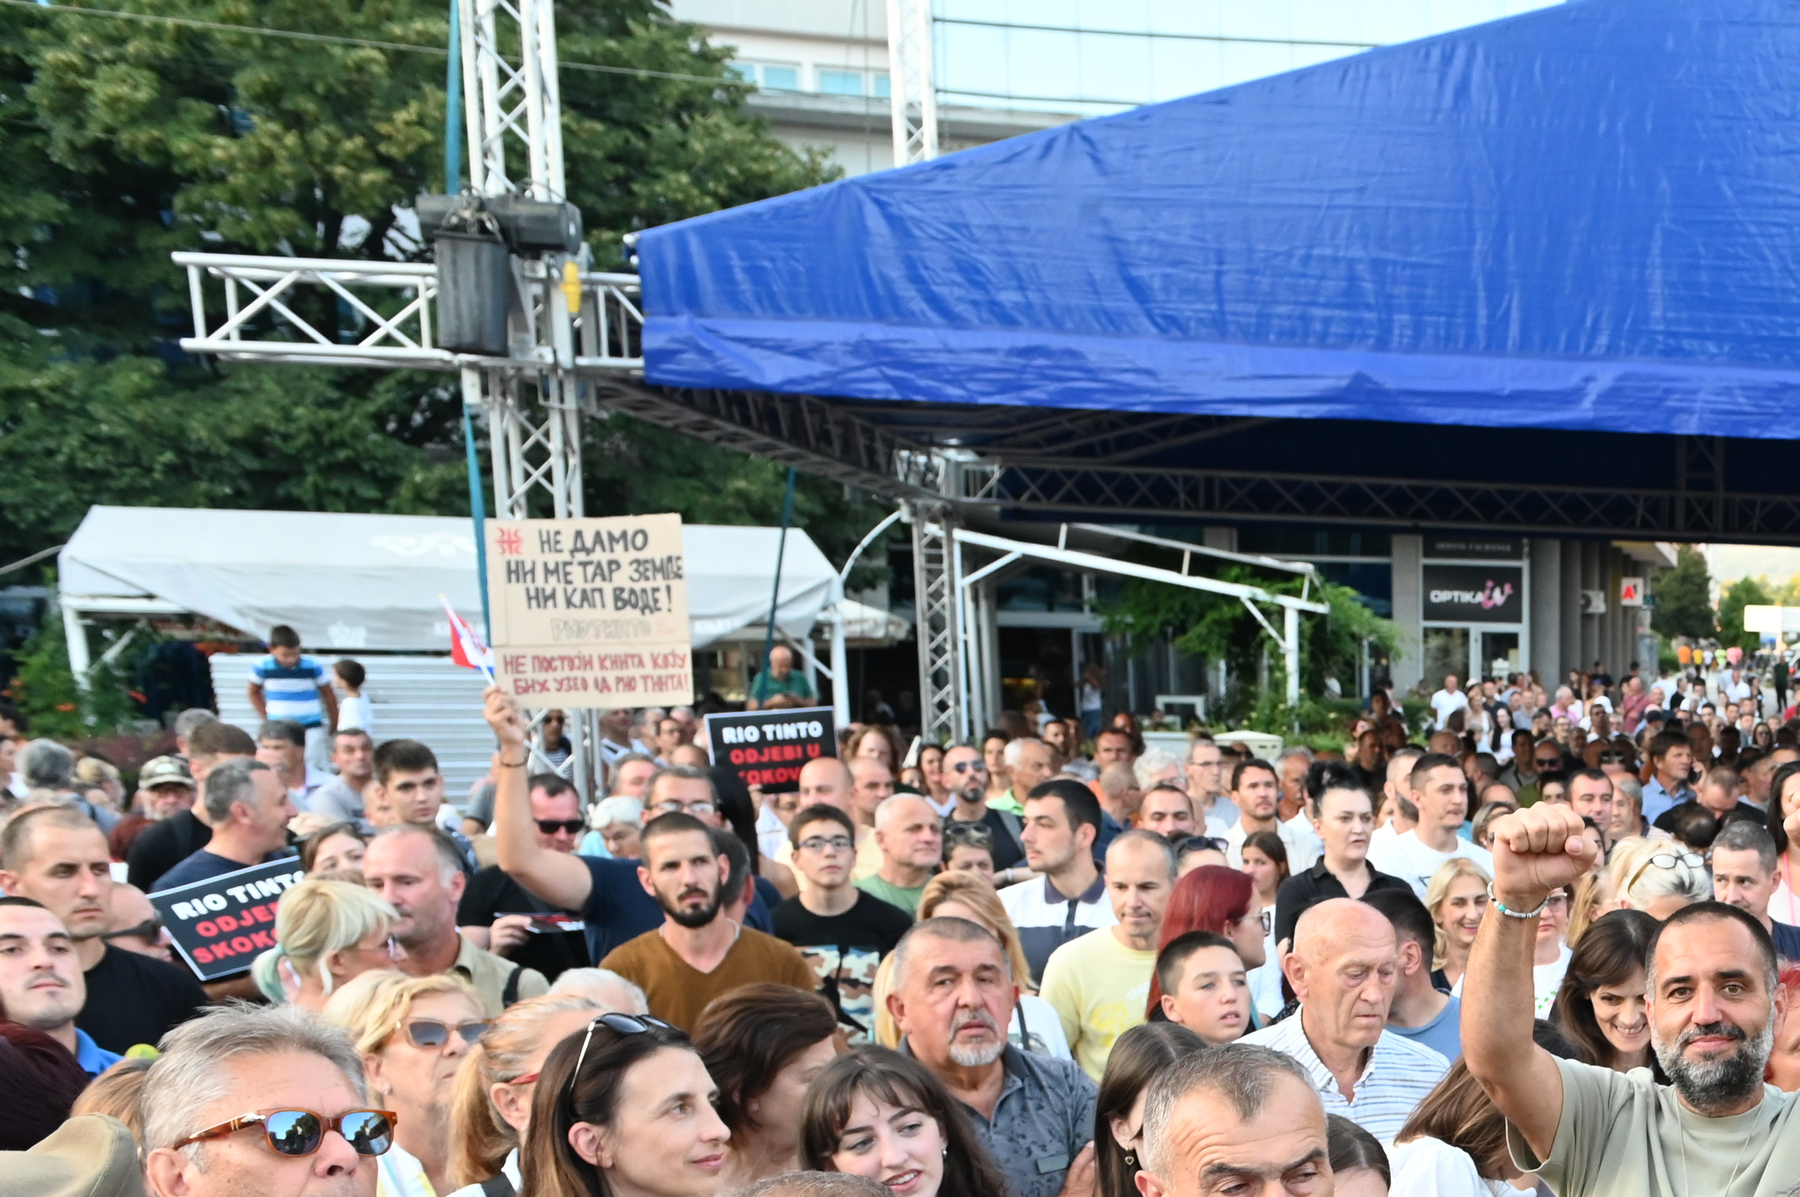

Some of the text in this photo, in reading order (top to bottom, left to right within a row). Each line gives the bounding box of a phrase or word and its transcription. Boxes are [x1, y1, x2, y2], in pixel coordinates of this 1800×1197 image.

[539, 528, 648, 558] НЕ ДАМО
[506, 559, 536, 584] НИ
[543, 558, 621, 585] МЕТАР
[525, 585, 672, 615] НИ КАП ВОДЕ!
[503, 653, 526, 674] НЕ
[722, 721, 823, 744] RIO TINTO
[806, 743, 821, 759] U
[171, 893, 228, 920] RIO
